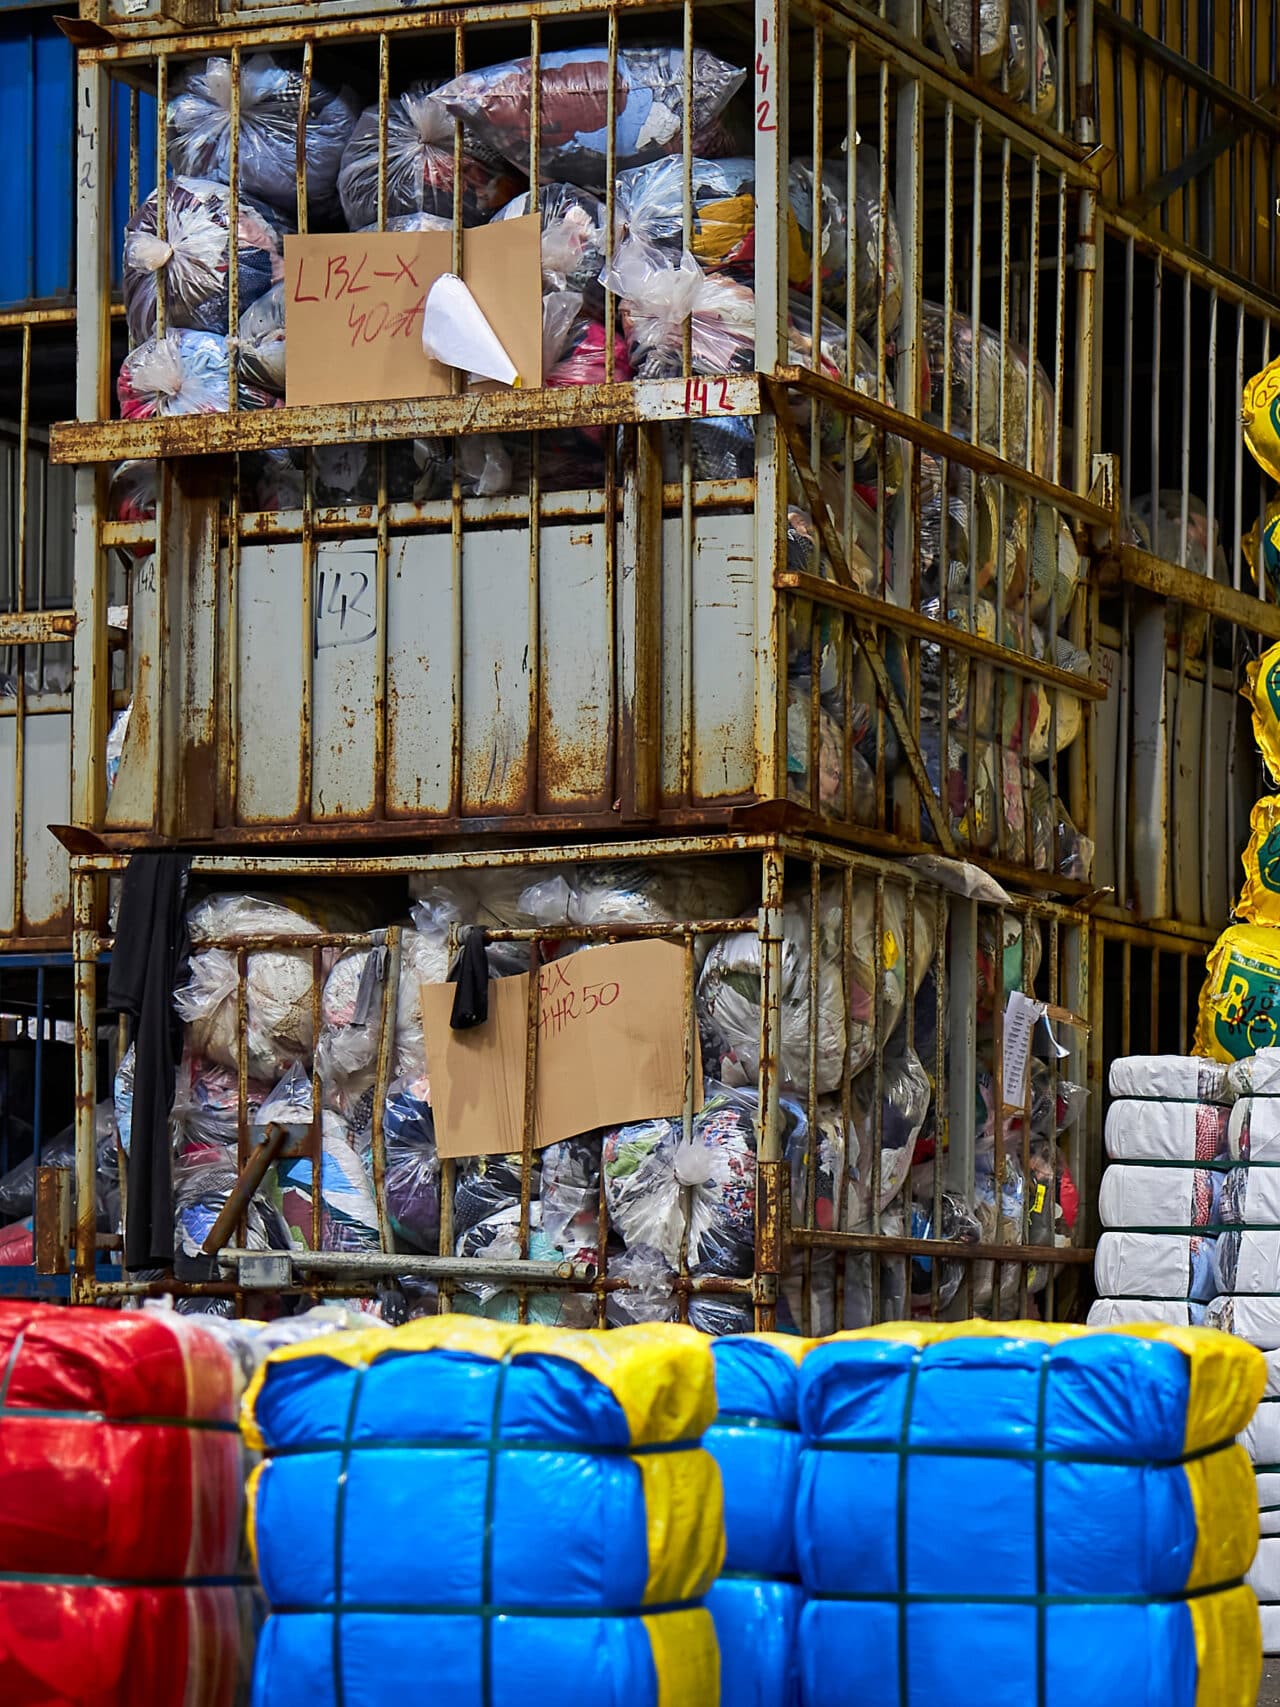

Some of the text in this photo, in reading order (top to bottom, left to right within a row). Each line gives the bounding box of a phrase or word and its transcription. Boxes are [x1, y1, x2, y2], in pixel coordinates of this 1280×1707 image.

[756, 18, 777, 131] 142
[684, 376, 736, 416] 142
[583, 982, 620, 1015] 50
